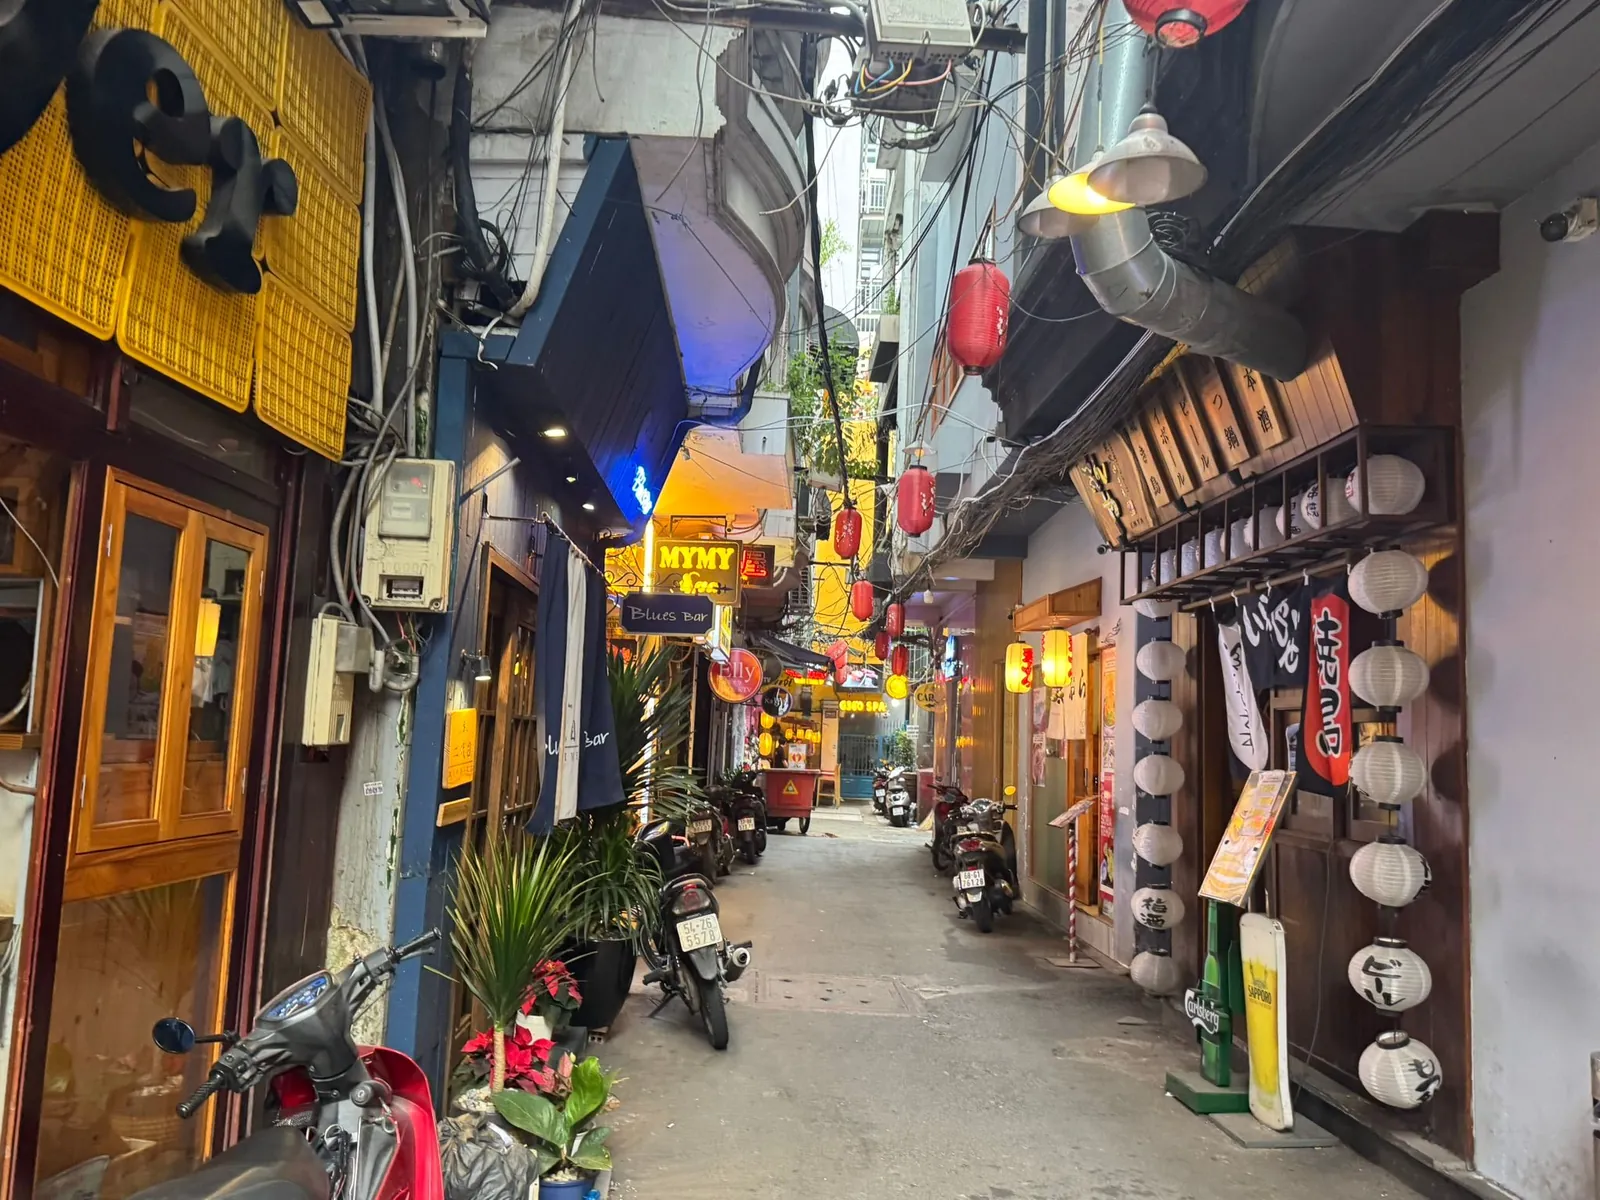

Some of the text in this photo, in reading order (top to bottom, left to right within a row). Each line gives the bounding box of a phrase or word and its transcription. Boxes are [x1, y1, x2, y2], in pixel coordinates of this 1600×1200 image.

[1243, 368, 1273, 433] 本酒
[1179, 399, 1210, 472] ビール
[1212, 393, 1240, 450] つ鍋
[1153, 407, 1186, 488] イボール
[659, 546, 735, 570] MYMY
[627, 605, 708, 622] Blues Bar
[720, 662, 755, 682] Elly
[1140, 897, 1167, 928] 梅酒
[687, 930, 715, 947] 5578
[1248, 984, 1272, 1004] SAPPORO
[1185, 989, 1219, 1033] Carlsberg
